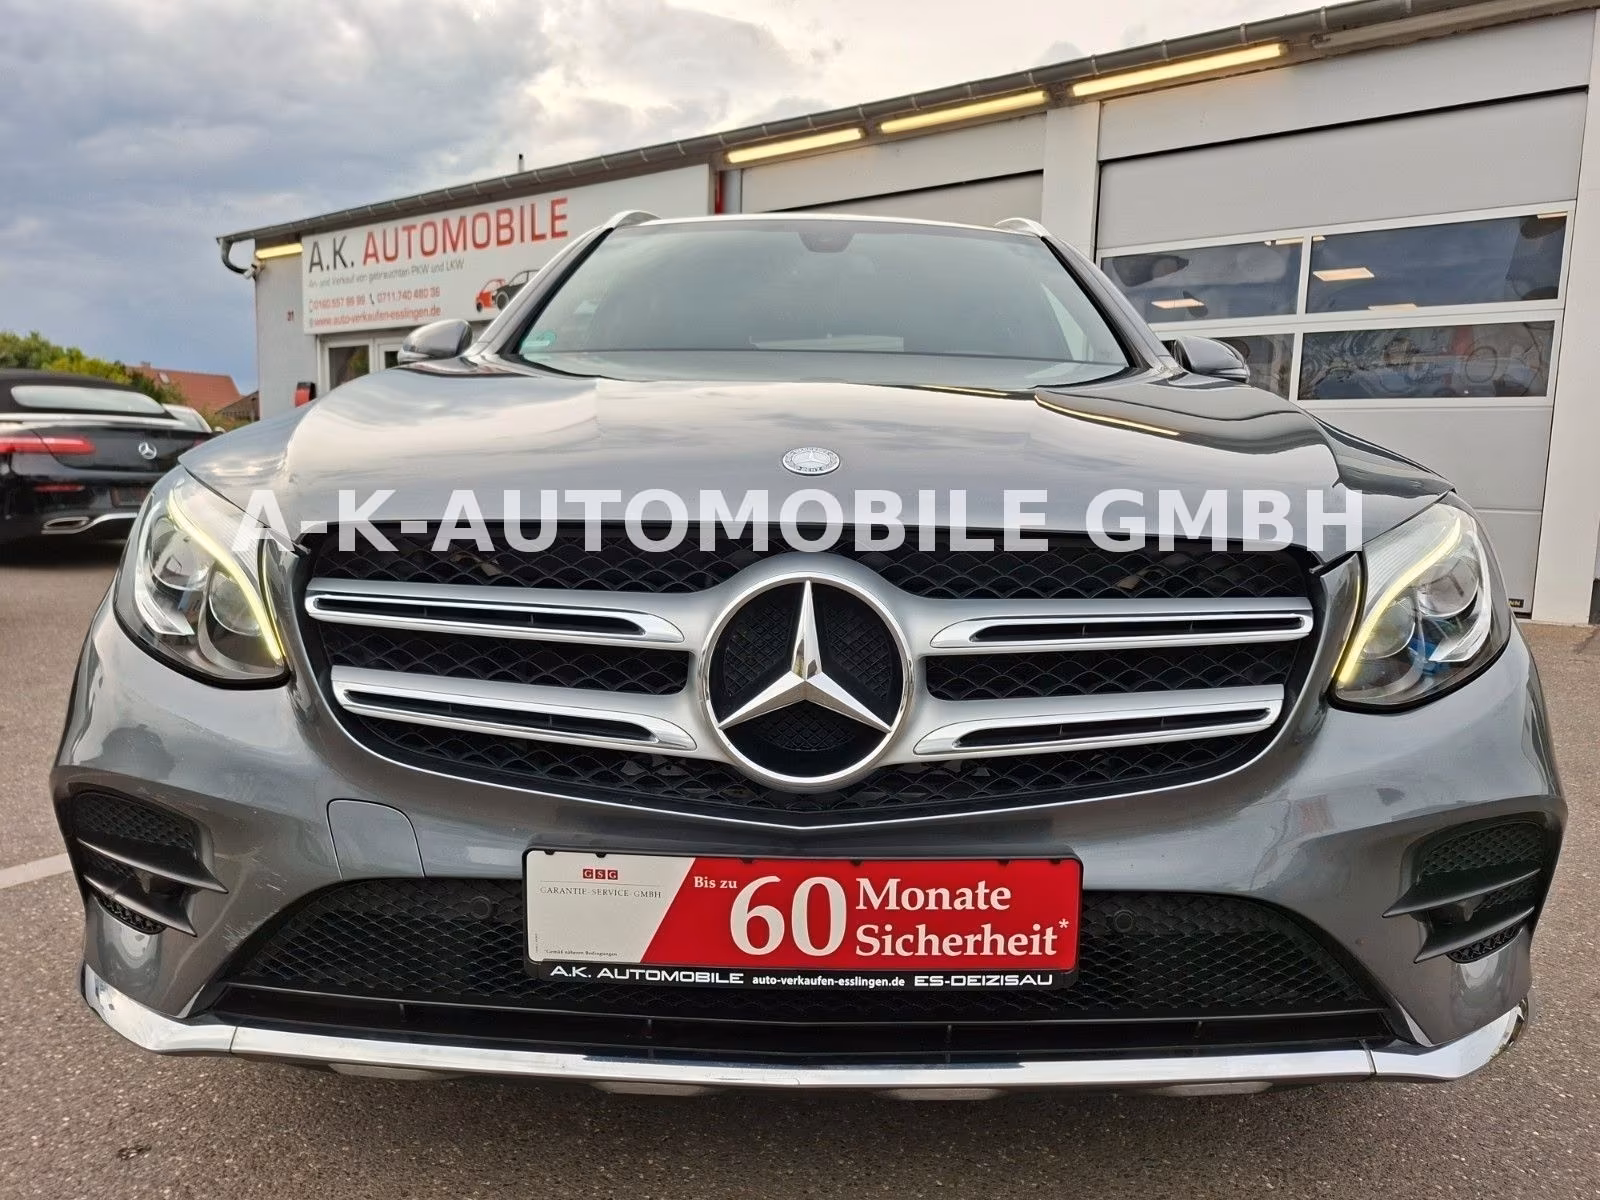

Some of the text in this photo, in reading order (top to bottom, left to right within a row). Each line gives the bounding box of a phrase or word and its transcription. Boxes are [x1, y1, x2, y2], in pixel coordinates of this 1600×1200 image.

[308, 197, 569, 273] A.K. AUTOMOBILE
[582, 868, 618, 880] GSG
[694, 876, 737, 889] Bis zu
[855, 877, 1012, 911] Monate
[730, 875, 847, 957] 60
[550, 965, 744, 984] A.K. AUTOMOBILE
[752, 975, 905, 988] auto-verkaufen-esslingen.de
[914, 974, 1053, 987] ES-DEIZISAU
